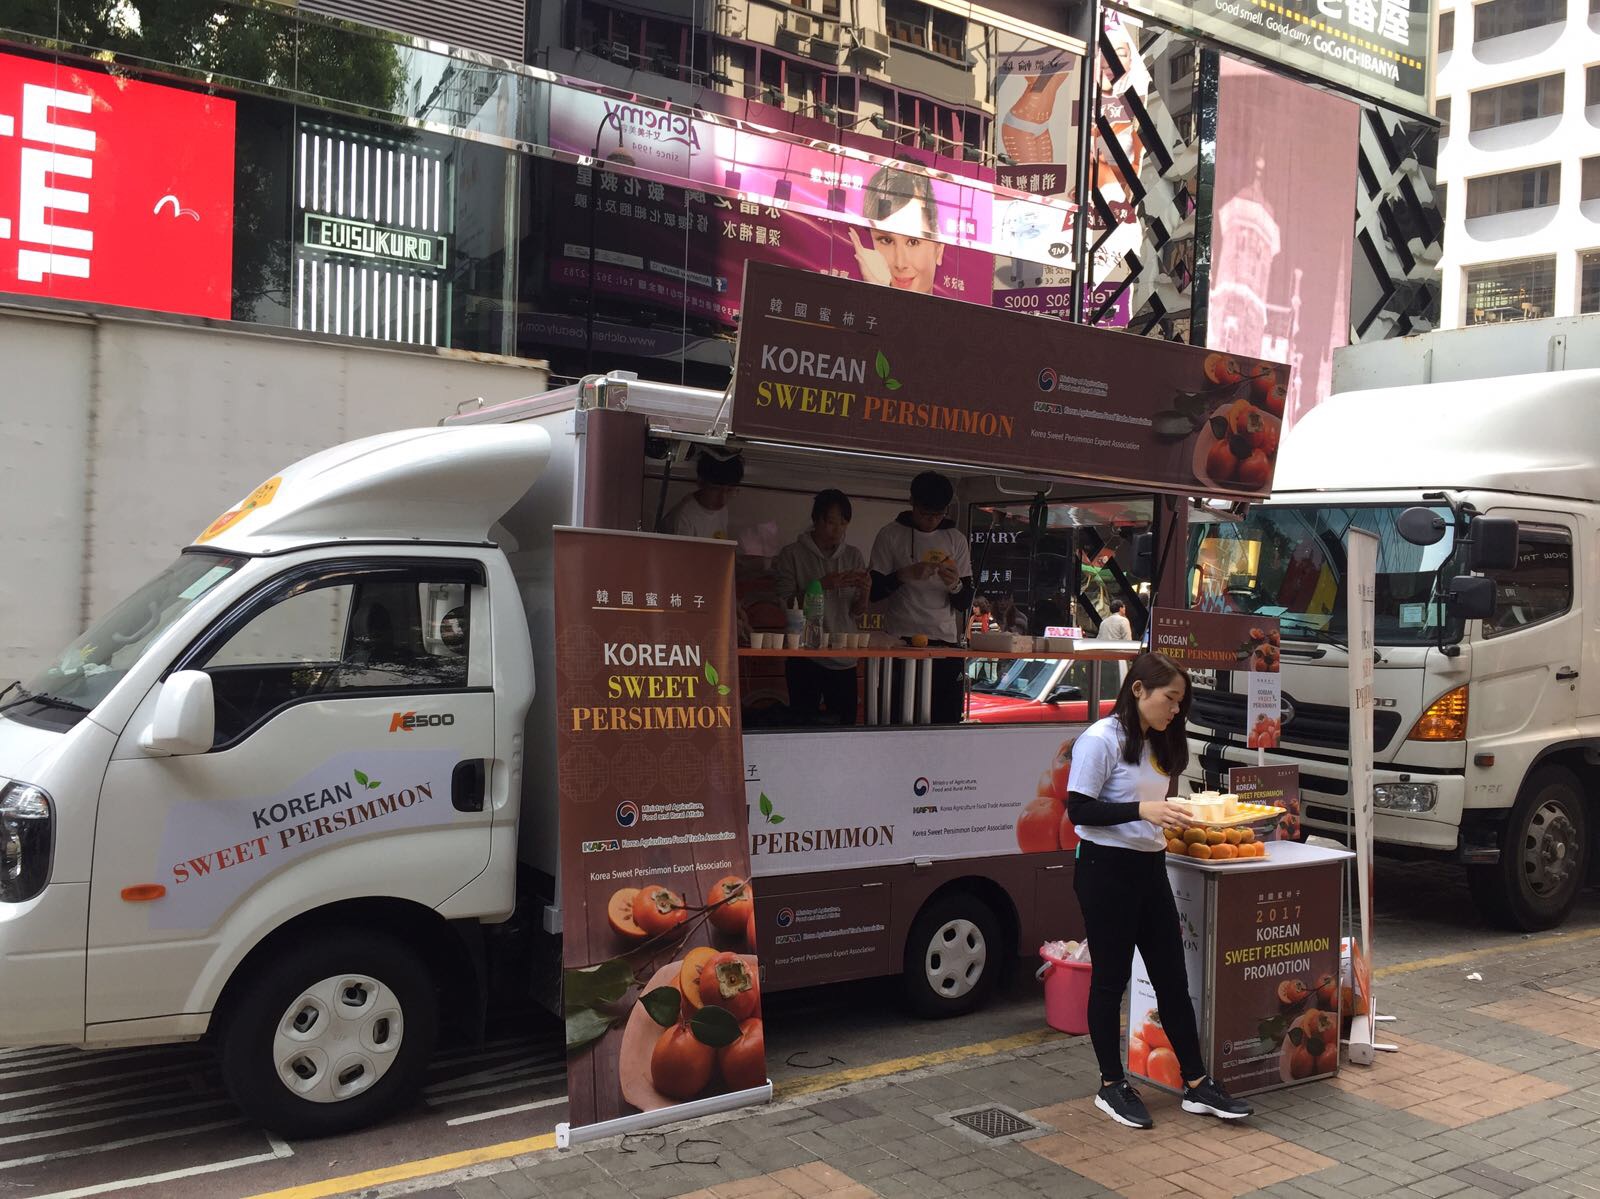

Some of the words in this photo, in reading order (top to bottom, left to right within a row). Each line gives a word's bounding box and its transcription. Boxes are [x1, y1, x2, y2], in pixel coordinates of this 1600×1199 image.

[1215, 0, 1238, 16] Good
[1240, 9, 1264, 26] smell.
[1266, 17, 1289, 36] Good
[1289, 28, 1312, 45] curry.
[319, 219, 432, 262] EVISUKURO
[770, 298, 878, 330] 韓國蜜柿子
[761, 344, 866, 384] KOREAN
[756, 381, 856, 418] SWEET
[863, 395, 1015, 440] PERSIMMON
[1031, 429, 1046, 438] Korea
[1048, 431, 1064, 440] Sweet
[1065, 434, 1094, 444] Persimmon
[1112, 440, 1140, 450] Association
[596, 589, 705, 608] 韓國蜜柿子
[1047, 627, 1074, 637] TAXI
[1158, 633, 1188, 646] KOREAN
[604, 642, 701, 667] KOREAN
[608, 675, 699, 699] SWEET
[571, 705, 732, 731] PERSIMMON
[252, 781, 353, 830] KOREAN
[172, 835, 270, 885] SWEET
[277, 782, 434, 850] PERSIMMON
[751, 824, 895, 857] PERSIMMON
[912, 829, 927, 837] Korea
[927, 828, 943, 836] Sweet
[944, 826, 970, 835] Persimmon
[971, 825, 986, 833] Export
[987, 823, 1013, 832] Association
[590, 871, 611, 881] Korea
[612, 868, 633, 879] Sweet
[634, 865, 672, 877] Persimmon
[673, 863, 695, 874] Export
[695, 859, 732, 871] Association
[1256, 906, 1301, 923] 2017
[1256, 924, 1300, 942] KOREAN
[1225, 948, 1261, 966] SWEET
[1264, 937, 1329, 959] PERSIMMON
[1243, 958, 1310, 980] PROMOTION
